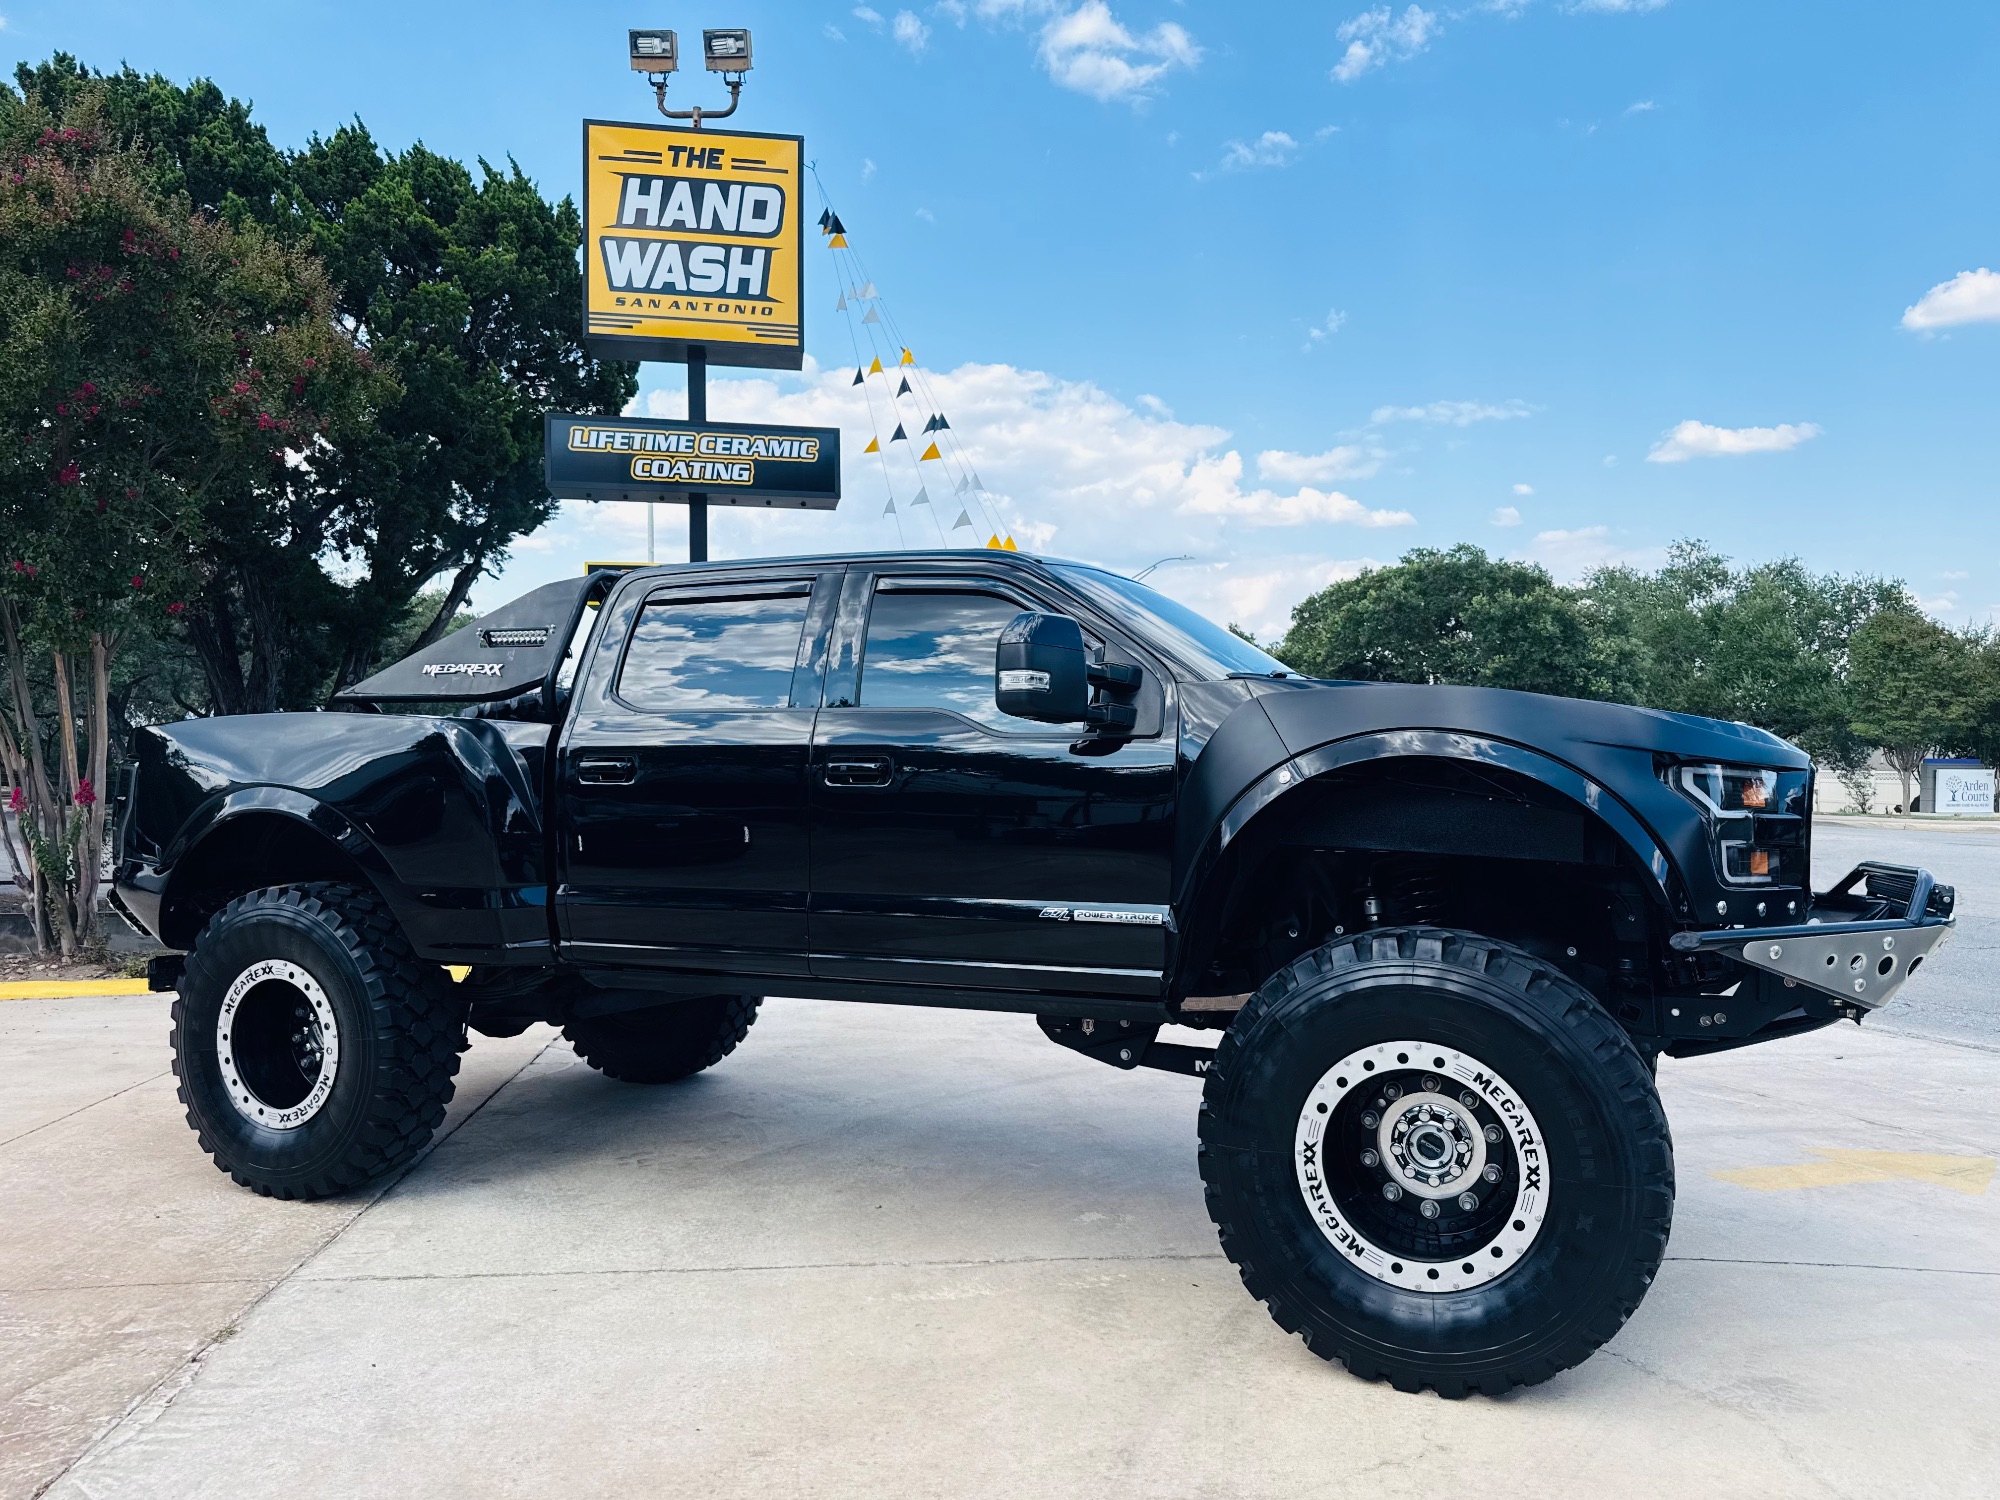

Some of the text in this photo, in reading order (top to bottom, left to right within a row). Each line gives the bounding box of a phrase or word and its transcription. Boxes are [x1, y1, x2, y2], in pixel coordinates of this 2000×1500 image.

[667, 145, 725, 170] THE
[622, 177, 783, 234] HAND
[604, 239, 766, 296] WASH
[570, 427, 818, 460] LIFETIME CERAMIC
[633, 457, 752, 482] COATING
[422, 662, 505, 678] MEGAREXX
[1961, 791, 1989, 802] Courts
[1962, 780, 1989, 791] Arden
[1076, 911, 1114, 919] POWER
[1116, 912, 1160, 921] STROKE
[224, 964, 276, 1016] MEGAREXX
[278, 1073, 332, 1124] MEGAREXX
[1471, 1070, 1542, 1193] MEGAREXX
[1303, 1139, 1366, 1258] MEGAREXX
